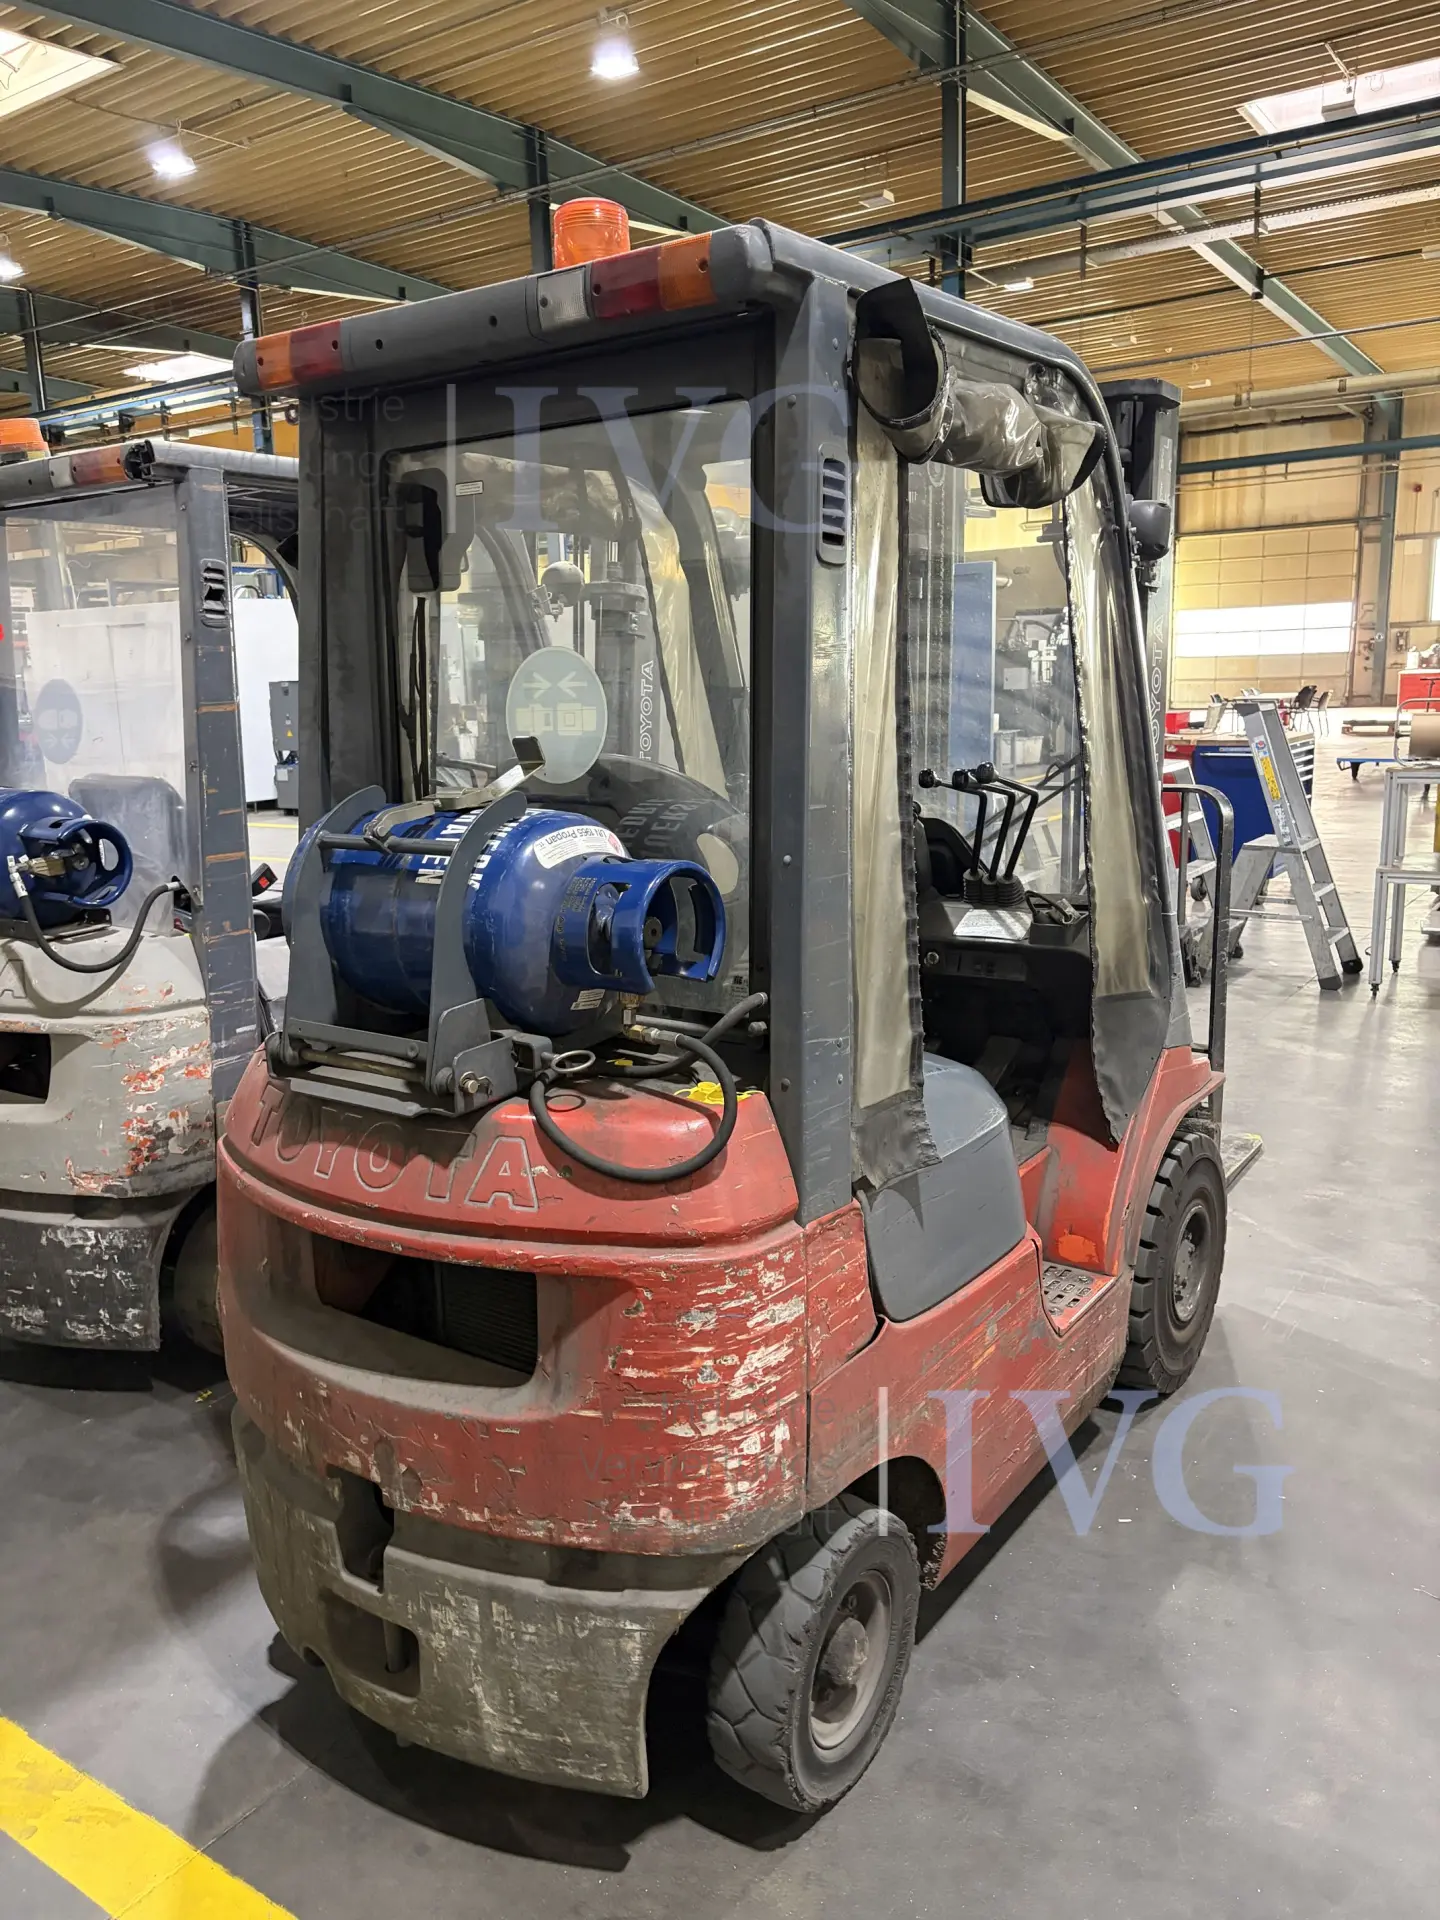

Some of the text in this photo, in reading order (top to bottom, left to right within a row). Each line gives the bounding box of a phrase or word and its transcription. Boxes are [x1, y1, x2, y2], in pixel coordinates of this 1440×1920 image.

[1150, 614, 1164, 762] OYOTA
[545, 828, 578, 845] Propan
[249, 1081, 539, 1212] TOYOTA
